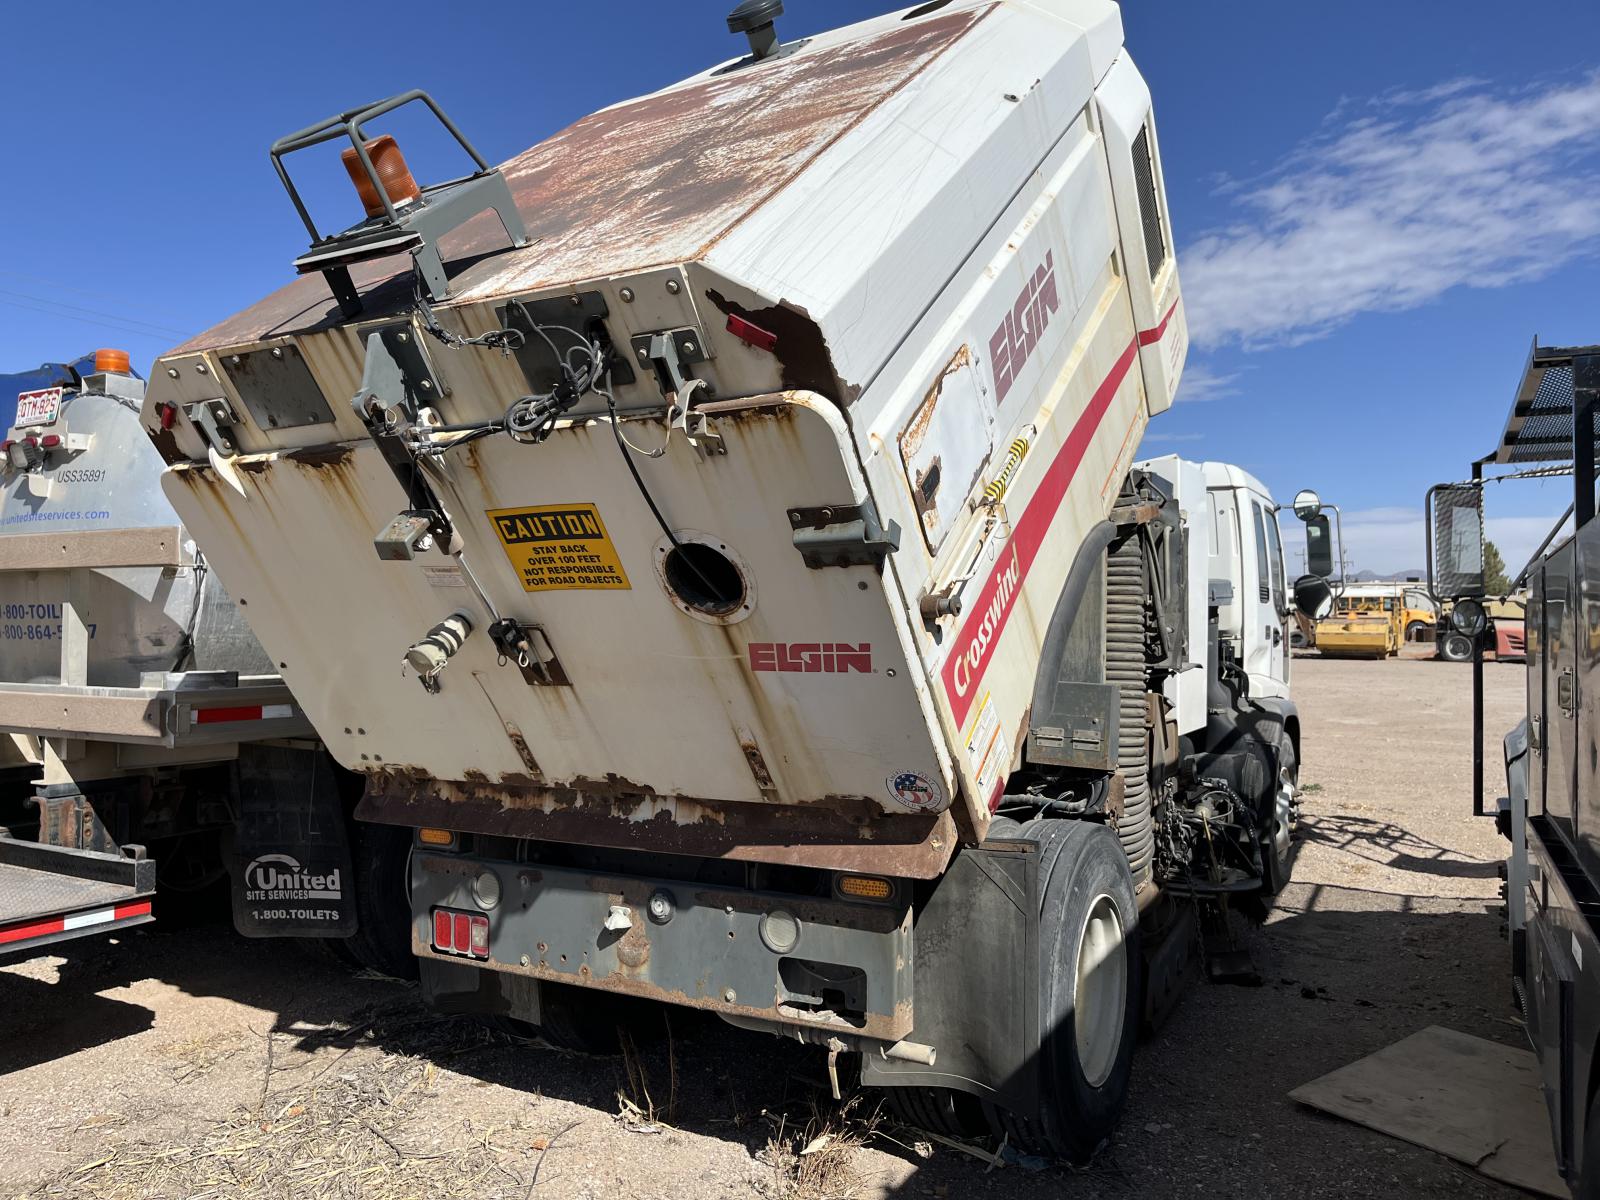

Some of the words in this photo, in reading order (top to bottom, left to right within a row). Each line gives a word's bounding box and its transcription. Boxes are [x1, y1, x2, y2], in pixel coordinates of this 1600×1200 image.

[988, 247, 1059, 408] ELGIN
[57, 469, 106, 483] USS35891
[498, 514, 599, 540] CAUTION
[532, 546, 557, 555] STAY
[560, 544, 588, 553] BACK
[528, 556, 556, 566] OVER
[558, 556, 576, 564] 100
[578, 555, 601, 563] FEET
[524, 567, 545, 576] NOT
[548, 565, 615, 575] RESPONSIBLE
[526, 577, 547, 586] FOR
[550, 576, 576, 585] ROAD
[578, 575, 623, 584] OBJECTS
[953, 541, 1021, 698] Crosswind
[748, 643, 872, 673] ELGIN
[256, 867, 341, 890] United
[246, 890, 266, 900] SITE
[268, 890, 309, 900] SERVICES
[252, 909, 340, 920] 1.800.TOILETS
